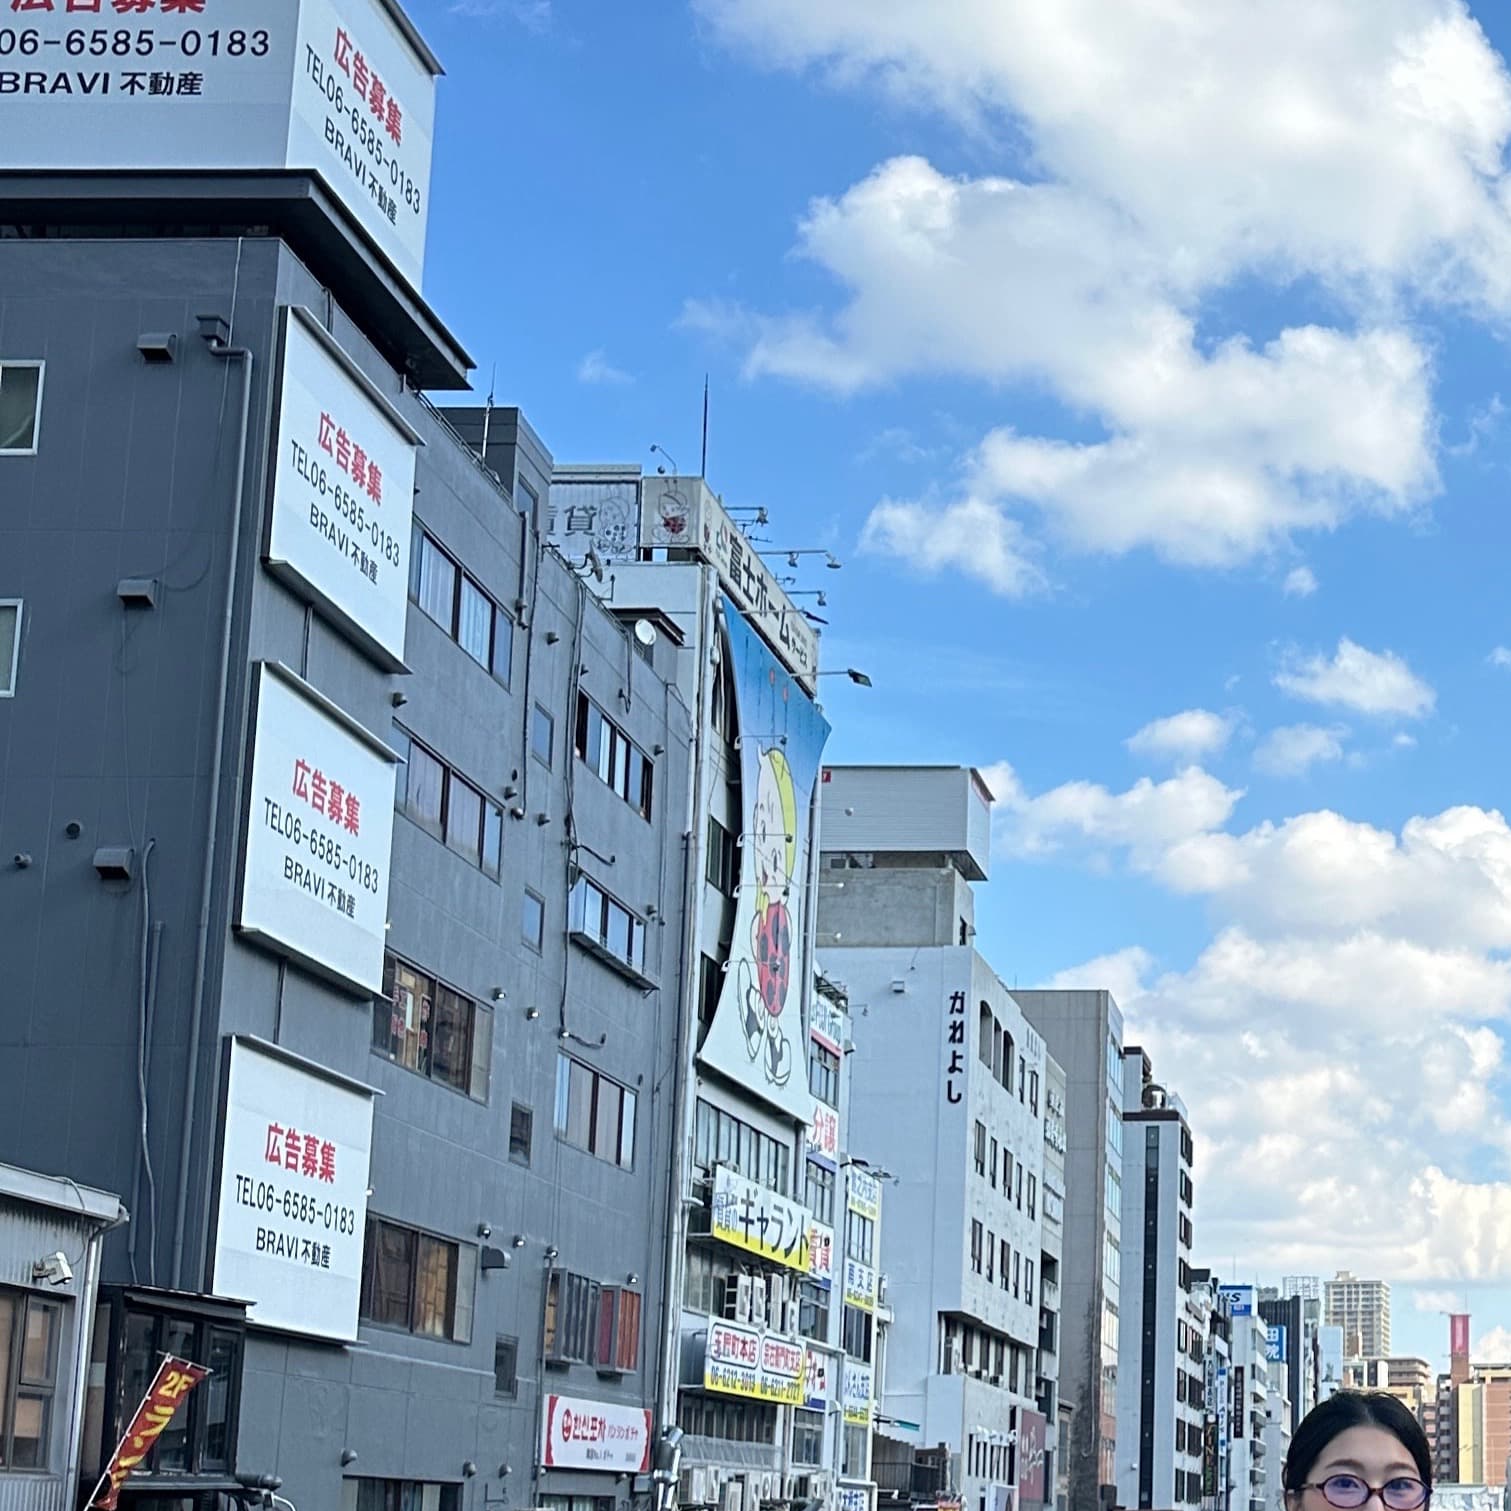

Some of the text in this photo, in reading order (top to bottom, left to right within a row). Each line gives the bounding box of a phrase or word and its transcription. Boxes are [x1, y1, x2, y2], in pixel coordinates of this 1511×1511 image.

[0, 71, 204, 96] BRAVI 不動産
[334, 27, 403, 147] 広告募集
[306, 43, 421, 215] TEL06-6585-0183
[324, 115, 399, 226] BRAVI 不動産
[317, 411, 383, 507] 広告募集
[291, 439, 400, 568] TEL06-6585-0183
[309, 502, 378, 585] BRAVI 不動産
[292, 758, 361, 838] 広告募集
[264, 796, 379, 895] TEL06-6585-0183
[283, 855, 356, 919] BRAVI 不動産
[946, 990, 966, 1105] かねよし
[264, 1121, 336, 1184] 広告募集
[236, 1173, 355, 1237] TEL06-6585-0183
[255, 1226, 332, 1270] BRAVI 不動産
[157, 1370, 196, 1399] 2F
